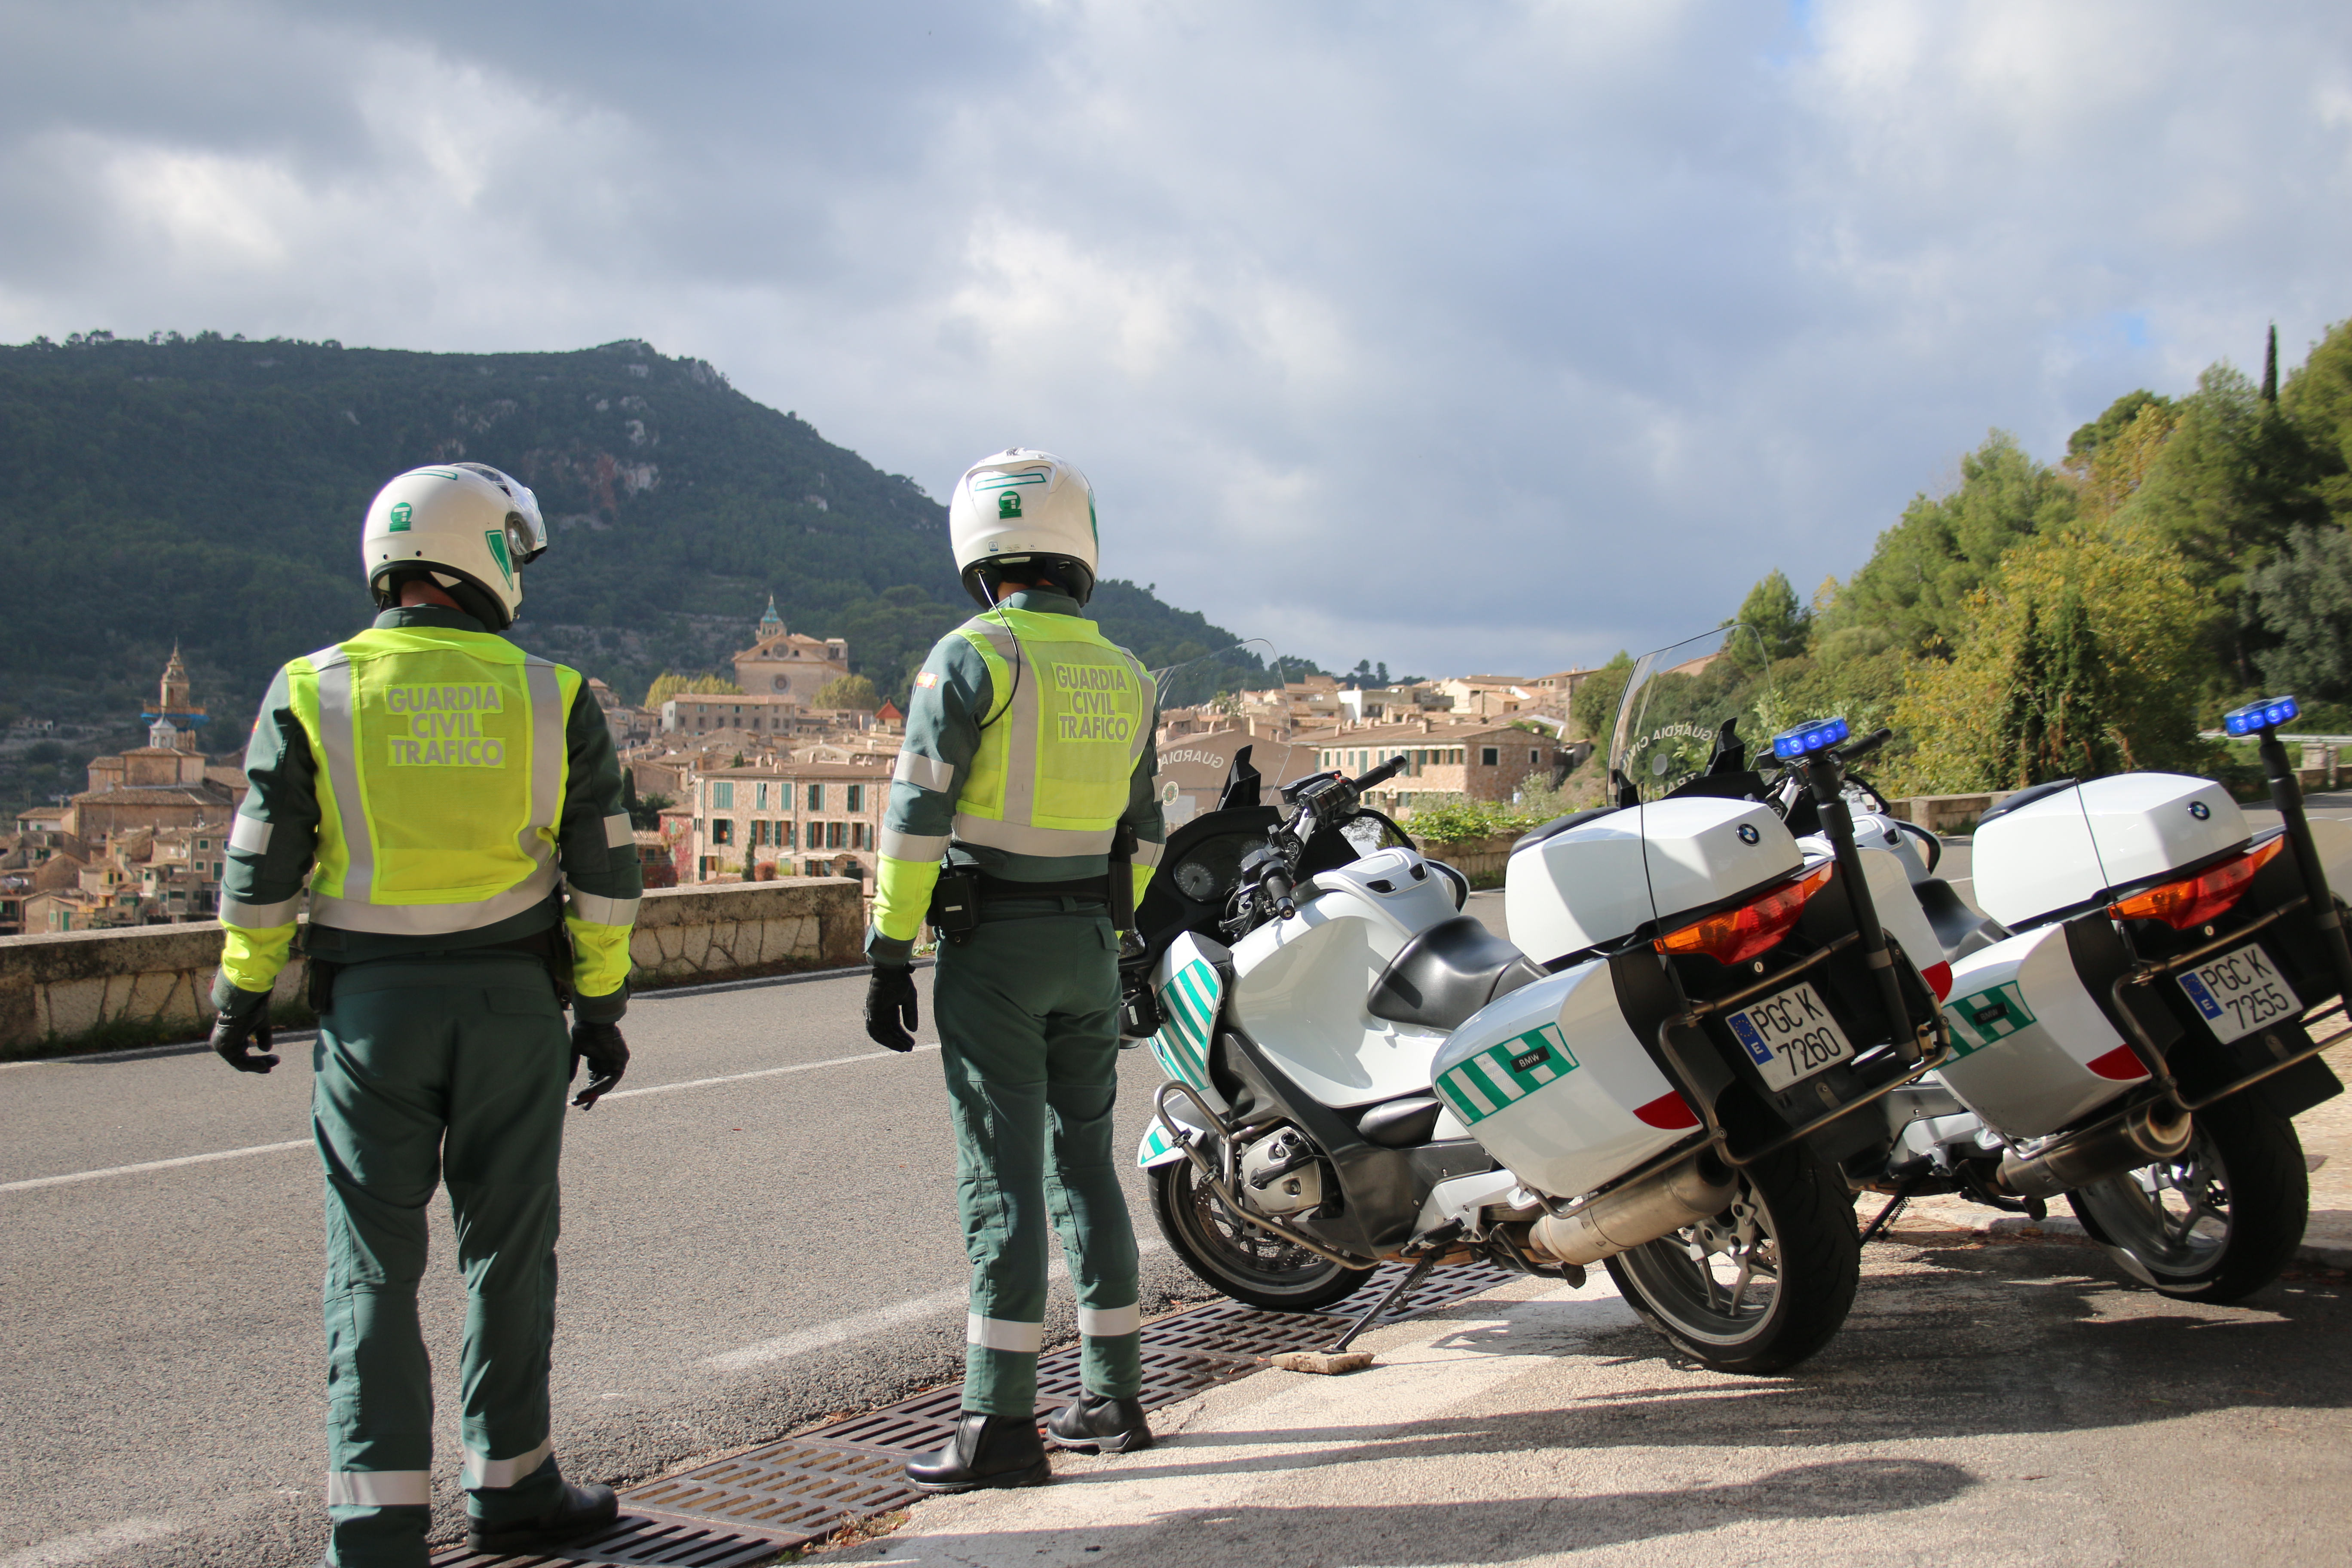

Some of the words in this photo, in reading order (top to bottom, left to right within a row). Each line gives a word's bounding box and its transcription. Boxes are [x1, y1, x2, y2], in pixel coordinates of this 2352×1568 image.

[1056, 665, 1127, 691] GUARDIA
[388, 686, 501, 713] GUARDIA
[1072, 692, 1115, 715] CIVIL
[412, 713, 481, 738] CIVIL
[1060, 717, 1128, 741] TRAFICO
[392, 739, 504, 766] TRAFICO
[2200, 959, 2251, 998] PGC
[2243, 949, 2272, 978] K
[1750, 998, 1803, 1041] PGC
[1795, 988, 1823, 1020] K
[1980, 1008, 1998, 1021] BMW
[2201, 999, 2213, 1010] E
[2226, 983, 2288, 1029] 7255
[1519, 1053, 1540, 1067] BMW
[1751, 1042, 1764, 1054] E
[1776, 1027, 1841, 1076] 7260
